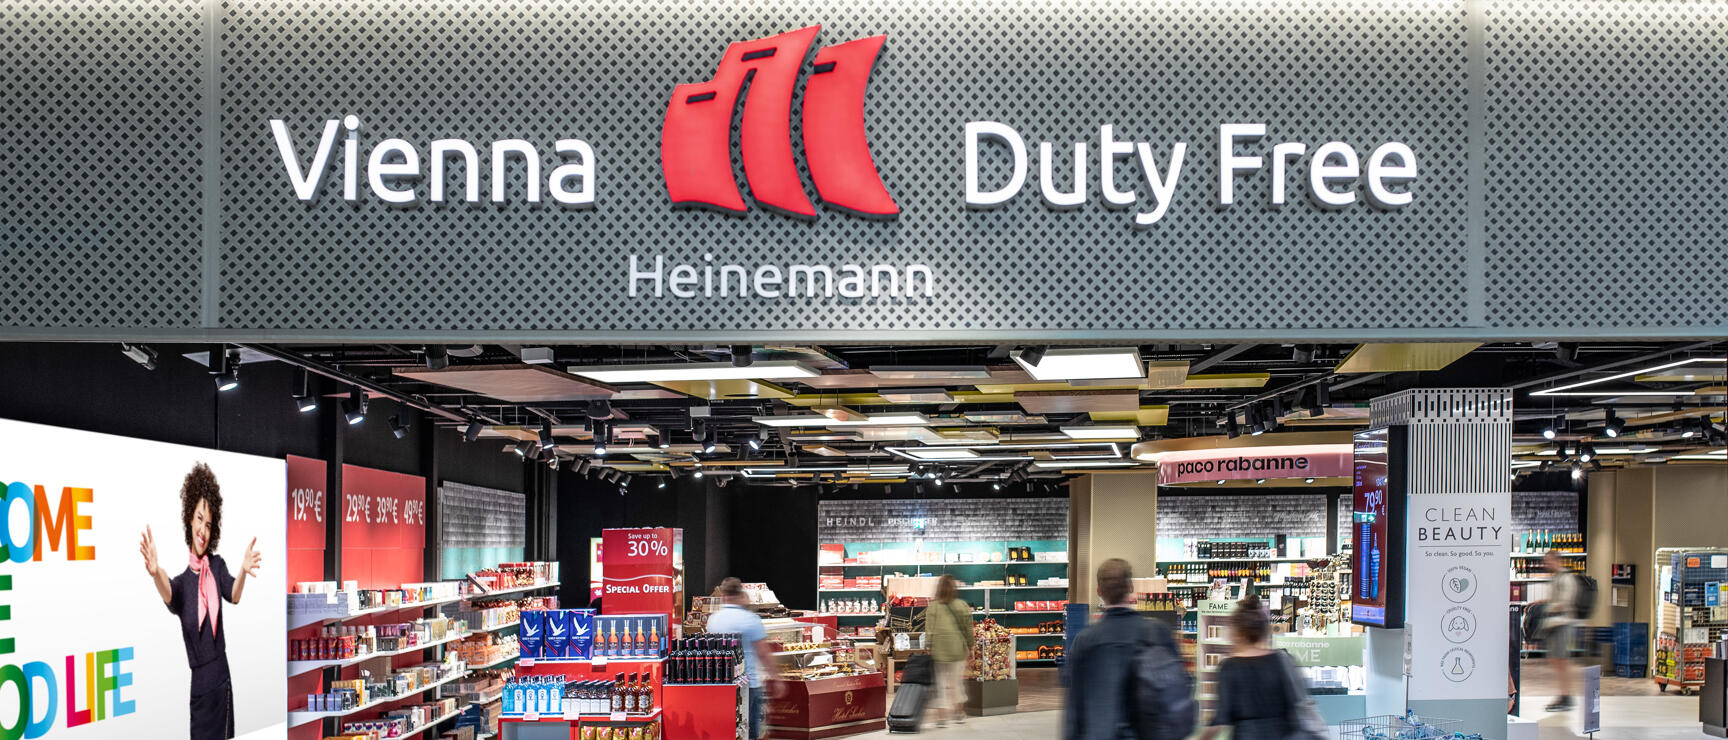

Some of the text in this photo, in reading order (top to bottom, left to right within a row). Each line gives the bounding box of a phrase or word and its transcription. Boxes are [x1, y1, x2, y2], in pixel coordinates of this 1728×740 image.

[269, 114, 596, 204] Vienna
[965, 121, 1417, 226] Duty Free
[628, 252, 934, 298] Heinemann
[1177, 456, 1309, 477] paco rabanne
[0, 481, 95, 563] OME
[826, 518, 875, 527] HEINDL
[1425, 507, 1495, 522] CLEAN
[1418, 526, 1502, 541] BEAUTY
[606, 583, 670, 594] SPECIAL OFFER
[65, 646, 136, 728] LIFE
